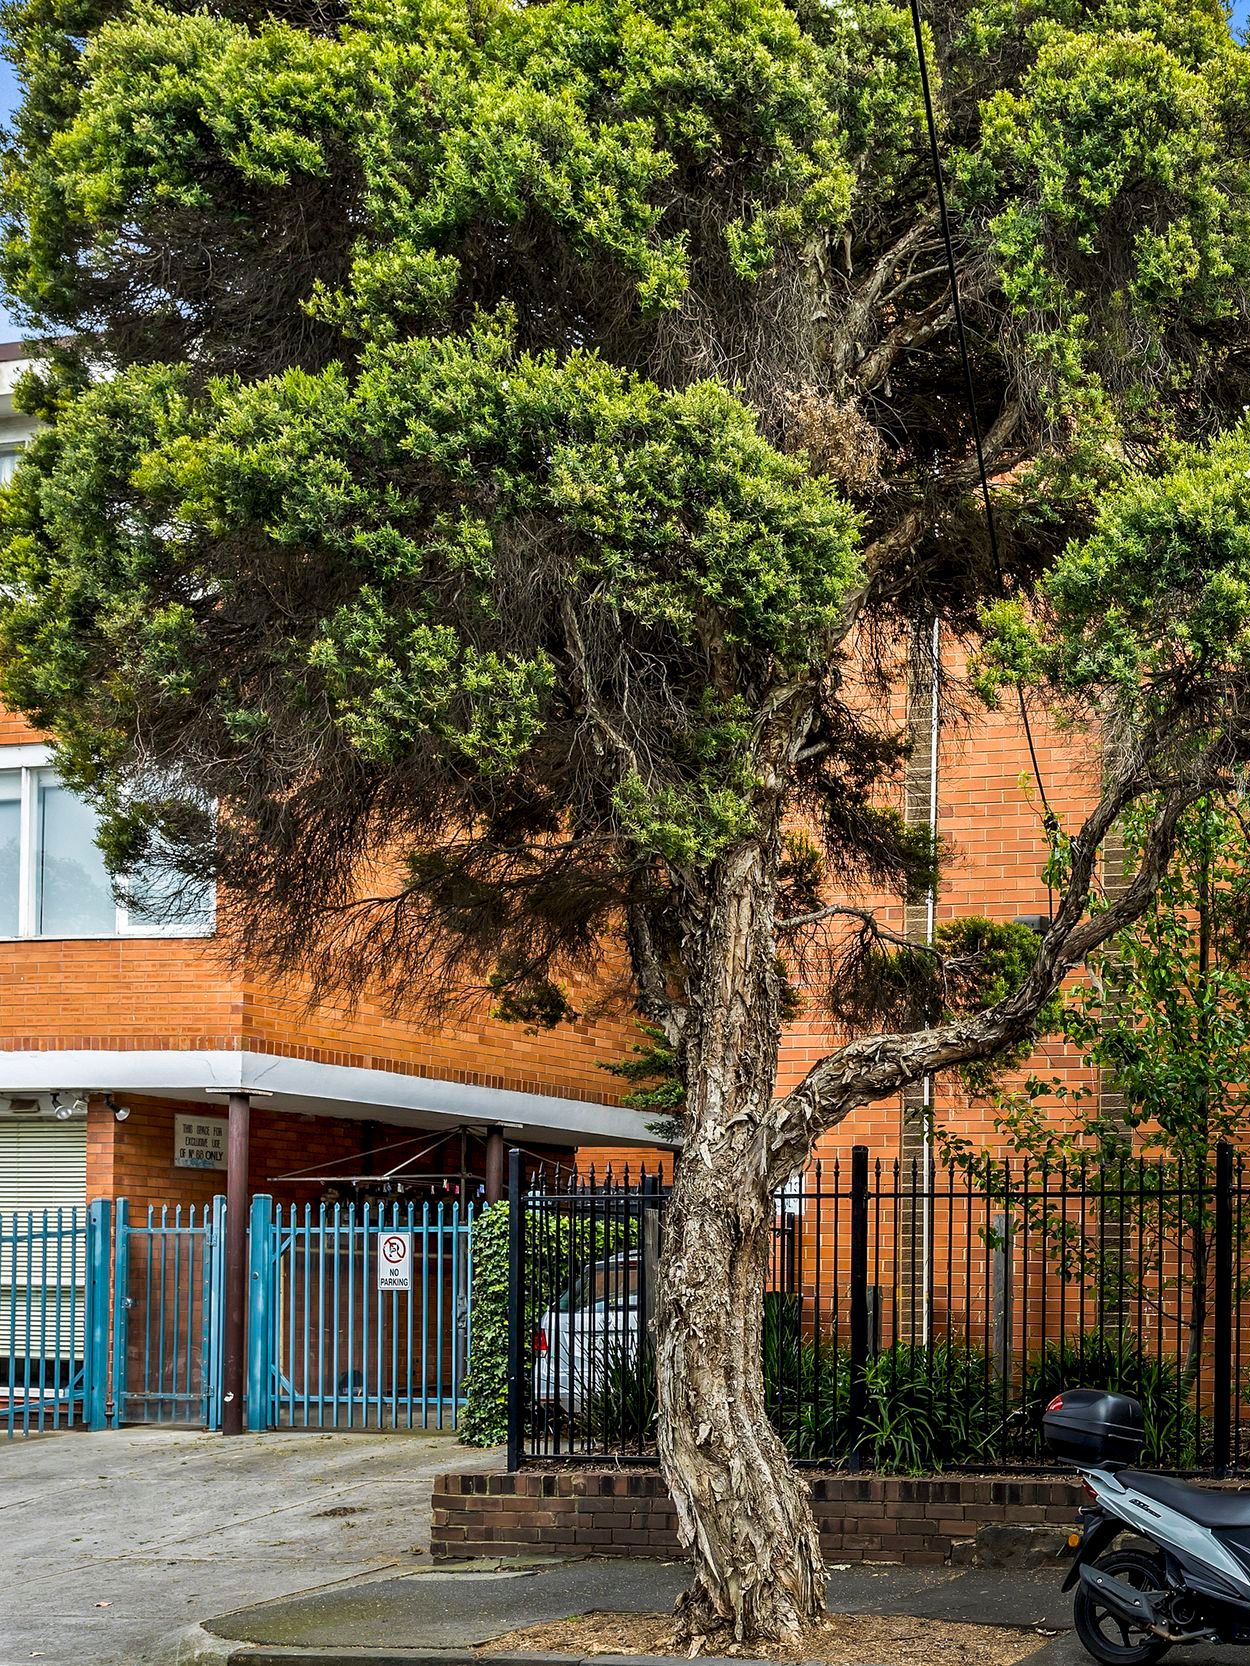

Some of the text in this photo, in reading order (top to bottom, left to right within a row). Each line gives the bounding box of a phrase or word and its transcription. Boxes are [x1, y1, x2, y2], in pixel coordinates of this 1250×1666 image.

[180, 1148, 186, 1158] OF
[205, 1150, 224, 1161] ONLY
[389, 1268, 400, 1277] NO
[380, 1277, 409, 1287] PARKING
